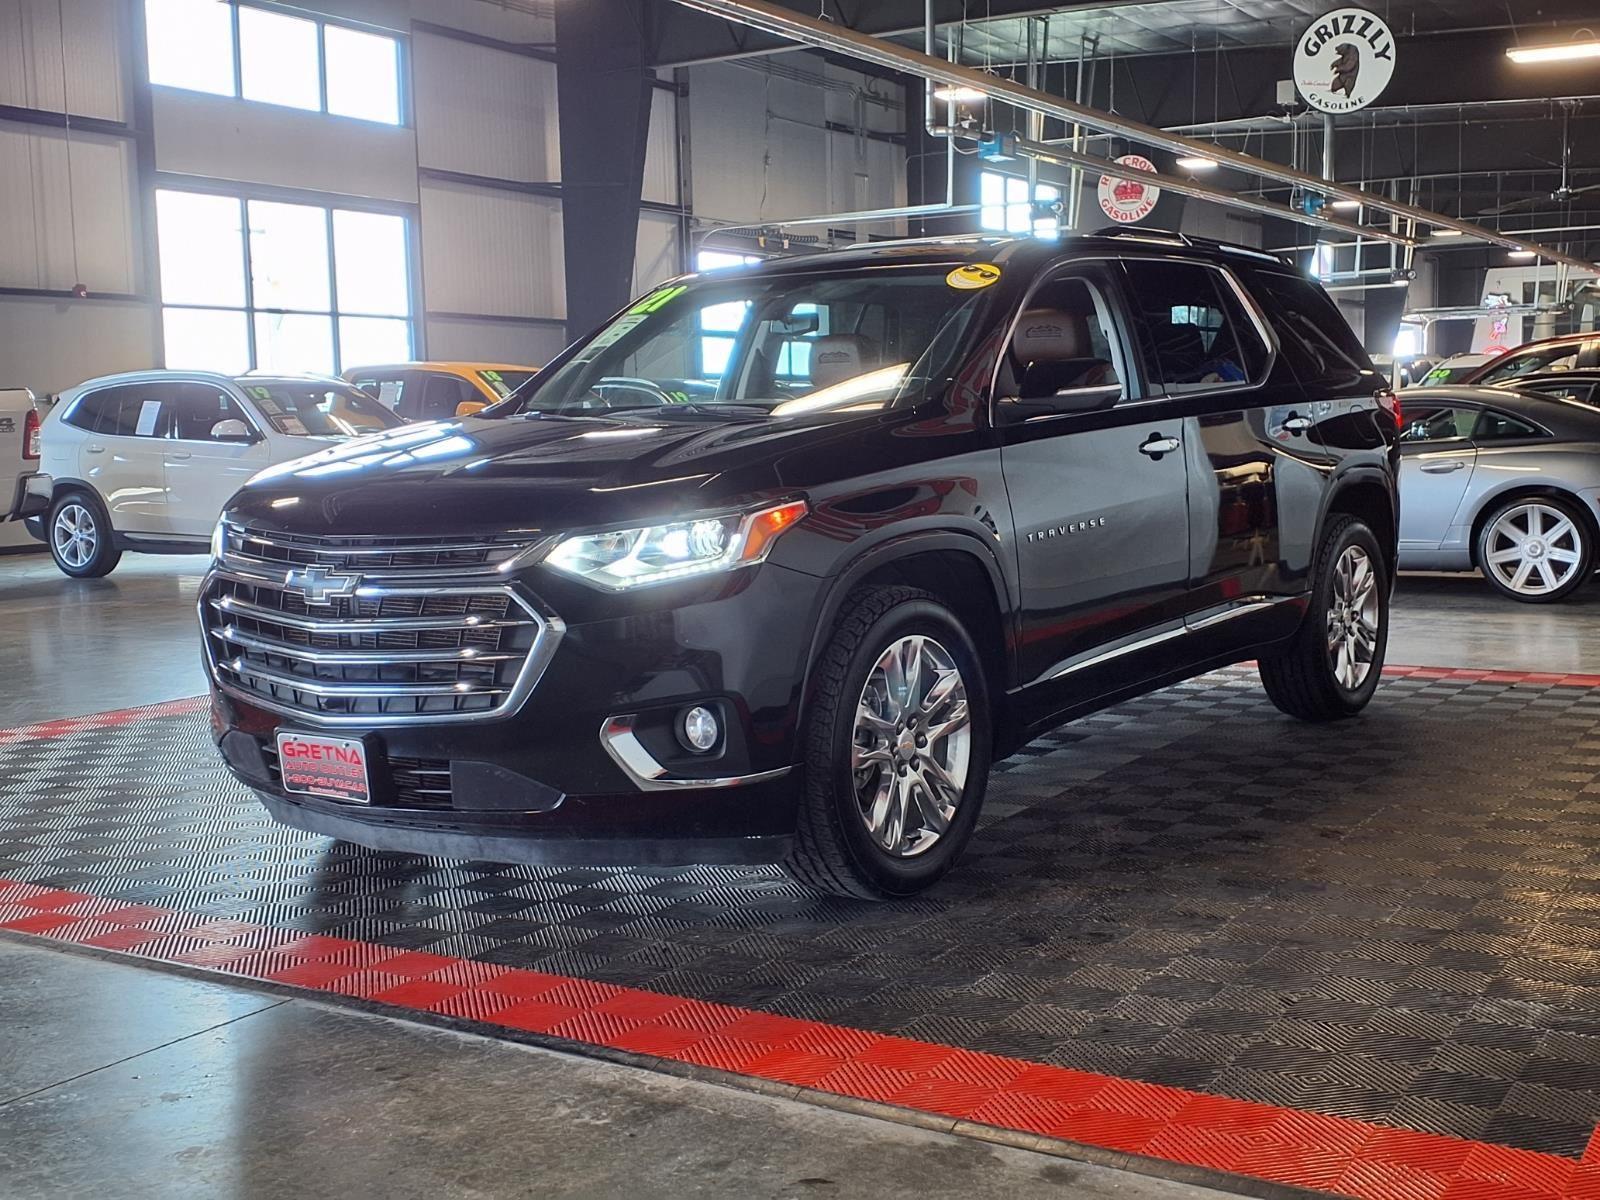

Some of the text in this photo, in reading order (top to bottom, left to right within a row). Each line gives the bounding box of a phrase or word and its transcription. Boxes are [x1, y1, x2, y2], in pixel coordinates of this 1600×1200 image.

[1304, 15, 1391, 61] GRIZZLY
[1309, 93, 1365, 110] GASOLINE
[1123, 157, 1153, 172] CROW
[1102, 198, 1154, 221] GASOLINE
[1429, 369, 1451, 378] 20
[246, 386, 271, 400] 19
[1027, 517, 1105, 542] TRAVERSE
[282, 741, 362, 765] GRETNA
[285, 760, 364, 778] AUTO OUTLET
